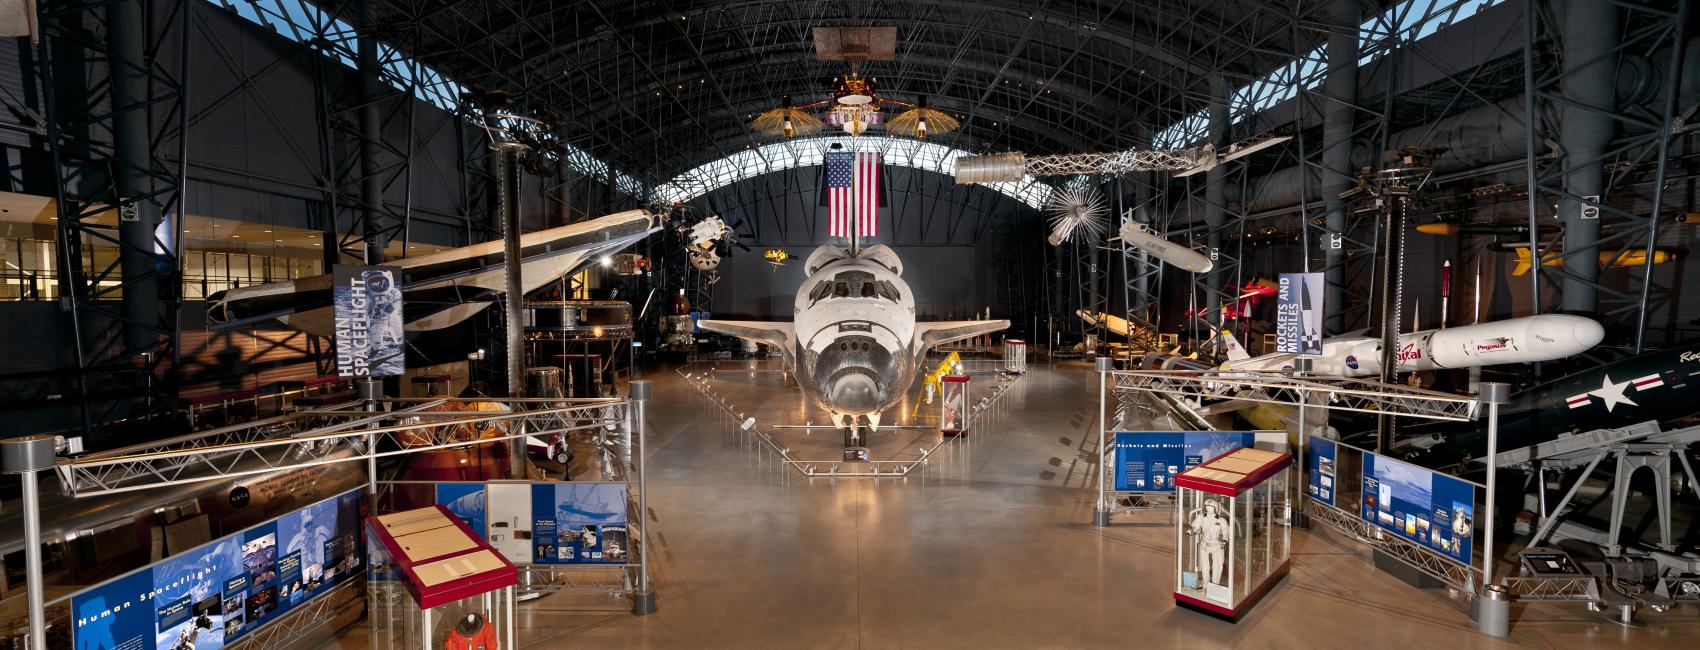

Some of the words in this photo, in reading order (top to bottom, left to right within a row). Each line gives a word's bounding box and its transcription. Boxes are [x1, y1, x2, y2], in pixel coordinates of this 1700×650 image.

[1279, 277, 1289, 301] AND
[335, 317, 353, 377] HUMAN
[351, 277, 370, 377] SPACEFLIGHT
[1277, 303, 1288, 352] ROCKETS
[1287, 303, 1299, 353] MISSILES
[1477, 343, 1507, 351] Pegasus
[231, 493, 249, 502] NASA
[78, 600, 131, 627] Human
[140, 565, 217, 612] Spaceflight
